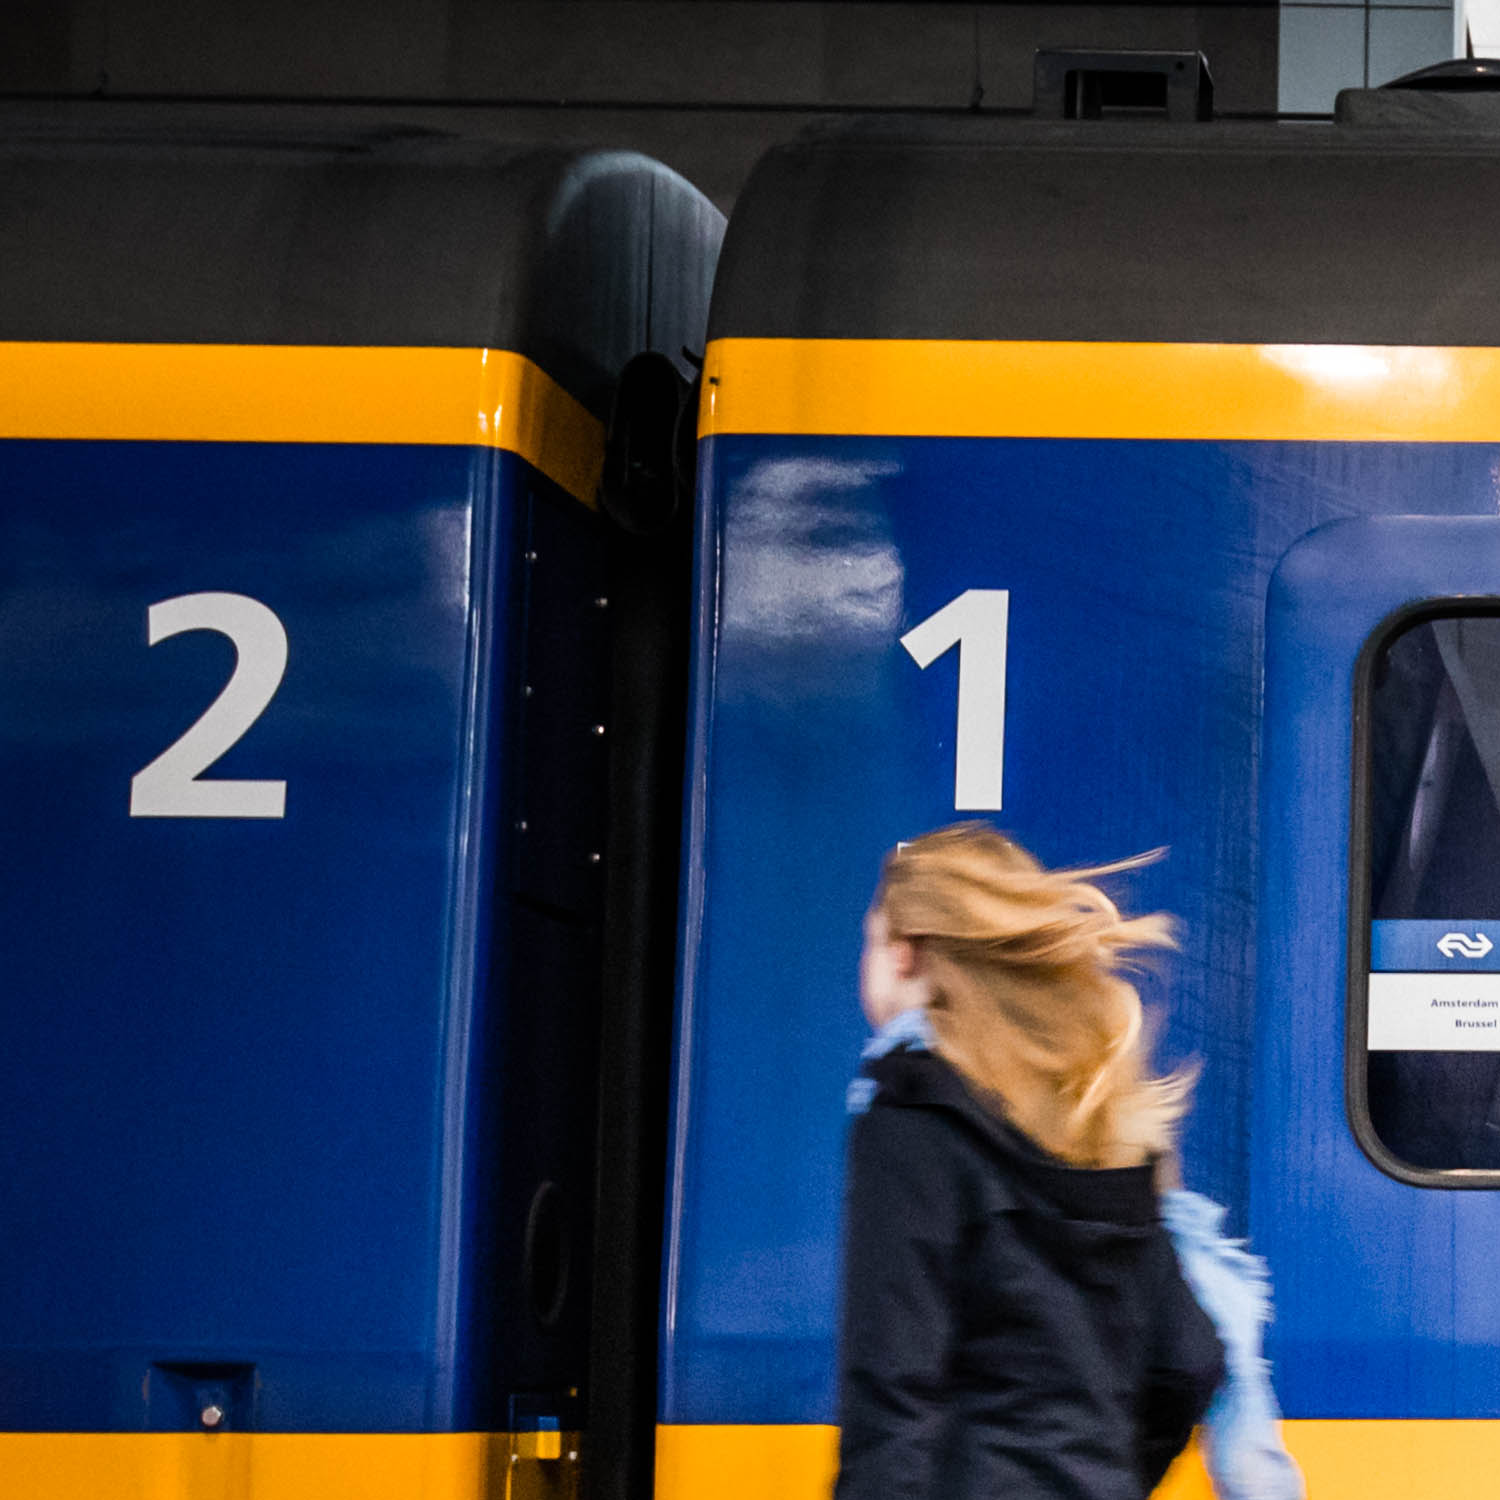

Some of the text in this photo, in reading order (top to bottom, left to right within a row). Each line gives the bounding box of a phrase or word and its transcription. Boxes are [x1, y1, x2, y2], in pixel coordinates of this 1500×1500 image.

[128, 590, 290, 820] 2
[898, 588, 1009, 812] 1
[1430, 998, 1499, 1008] Amsterdam
[1455, 1019, 1497, 1028] Brussel
